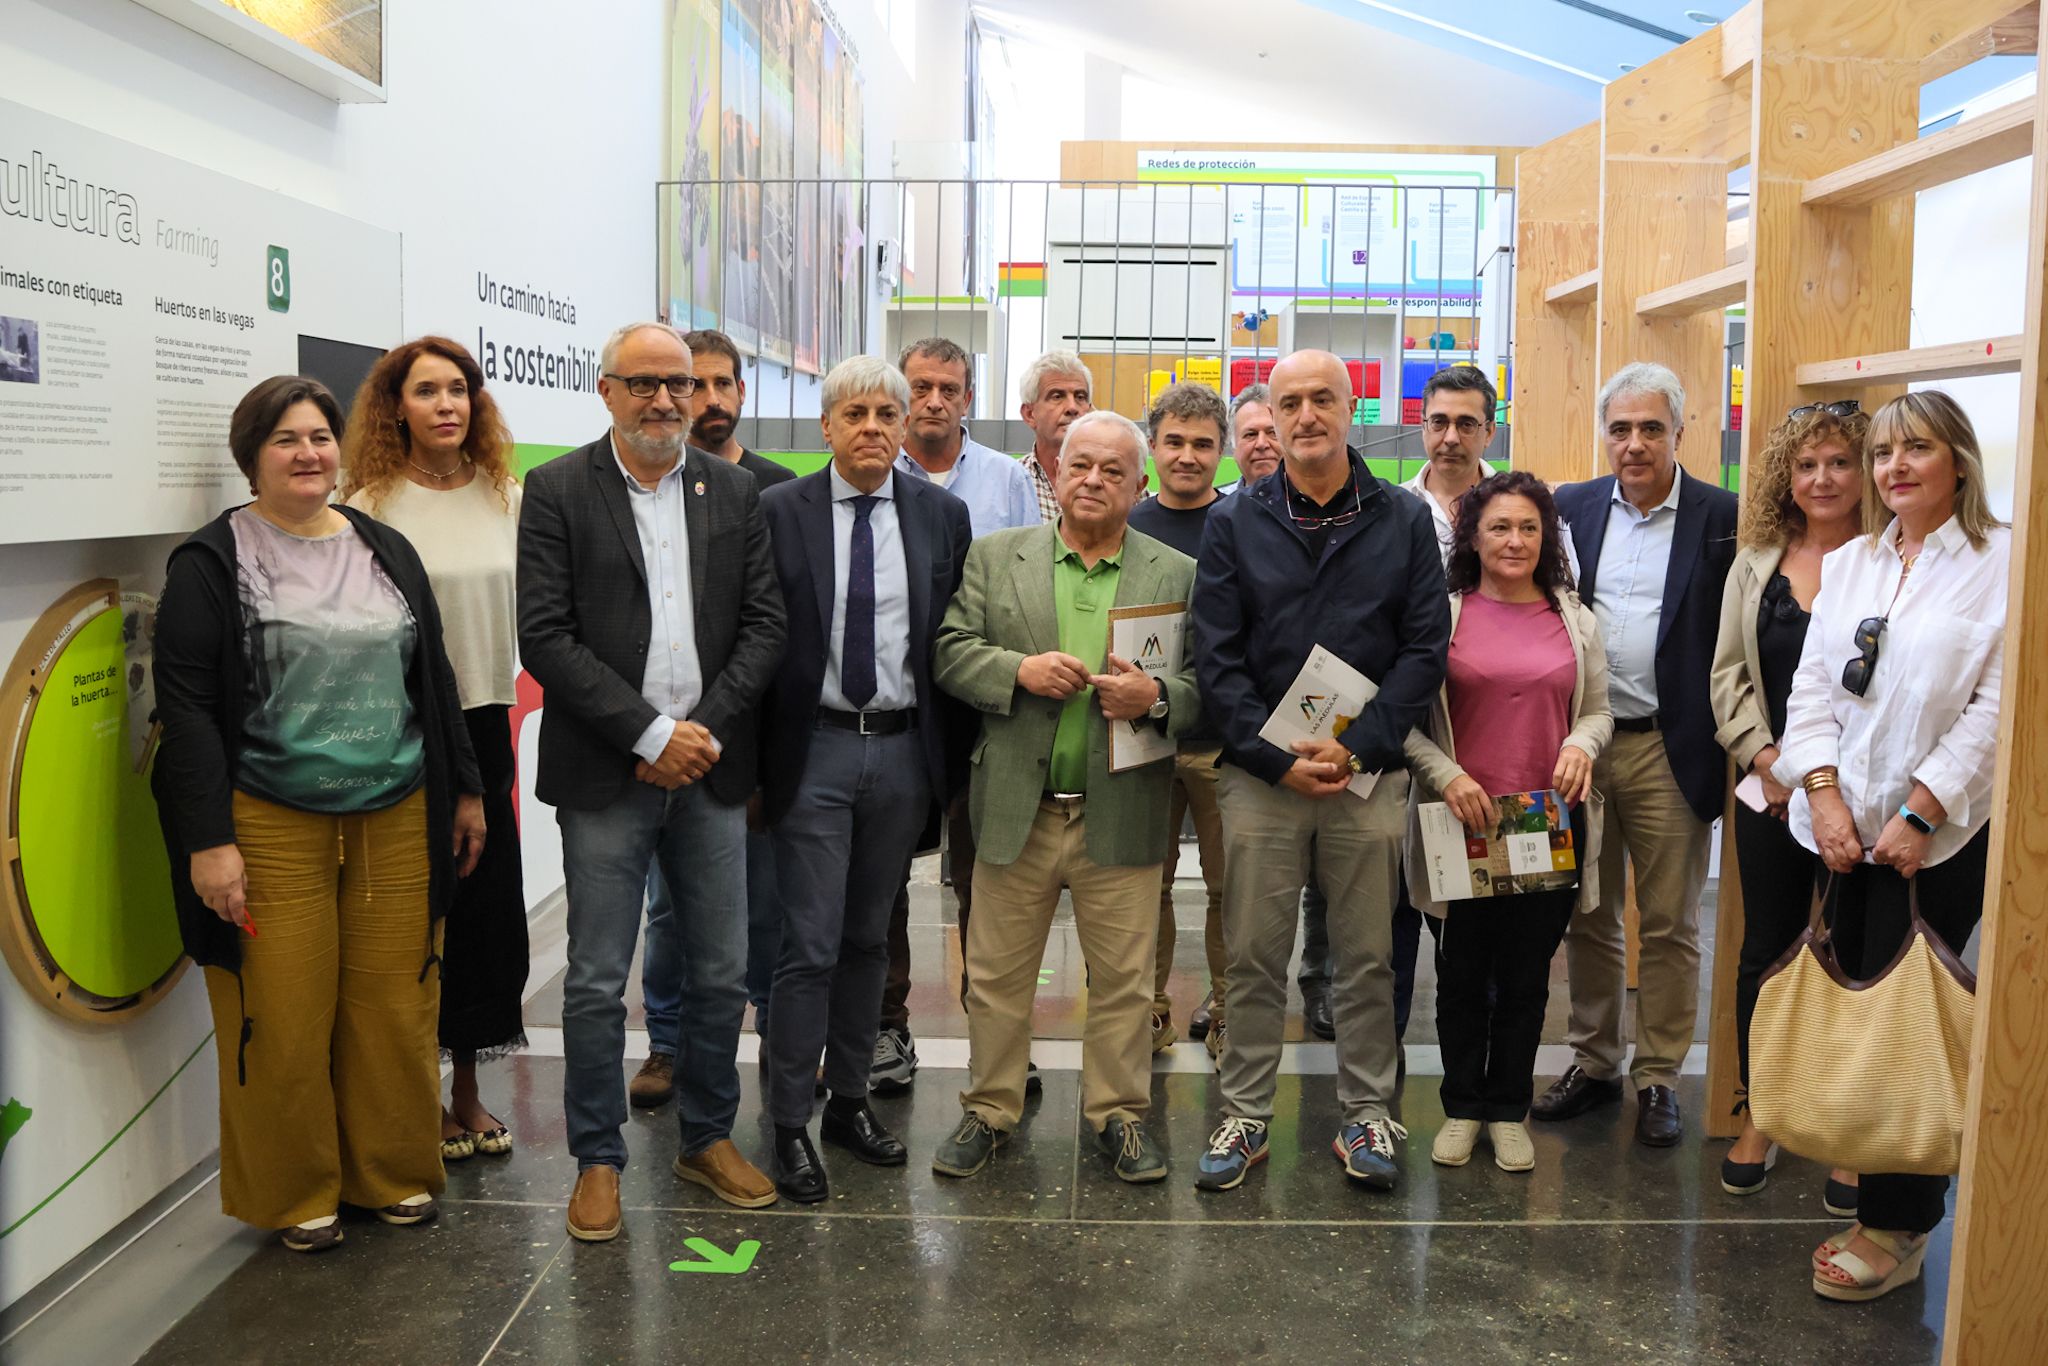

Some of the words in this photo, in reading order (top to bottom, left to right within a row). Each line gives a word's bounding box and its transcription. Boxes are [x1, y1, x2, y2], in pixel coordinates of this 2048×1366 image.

[1148, 159, 1180, 168] Redes
[1183, 159, 1196, 168] de
[1198, 159, 1256, 170] protección
[155, 219, 219, 268] Farming
[1353, 251, 1367, 262] 12
[0, 265, 45, 293] imales
[47, 280, 70, 297] con
[73, 281, 123, 307] etiqueta
[271, 257, 284, 298] 8
[155, 296, 197, 319] Huertos
[199, 307, 211, 321] en
[213, 306, 226, 324] las
[228, 312, 255, 331] vegas
[478, 271, 497, 305] Un
[500, 283, 546, 318] camino
[548, 291, 577, 326] hacia
[479, 326, 497, 381] la
[73, 668, 105, 688] Plantas
[106, 665, 117, 678] de
[71, 694, 79, 708] la
